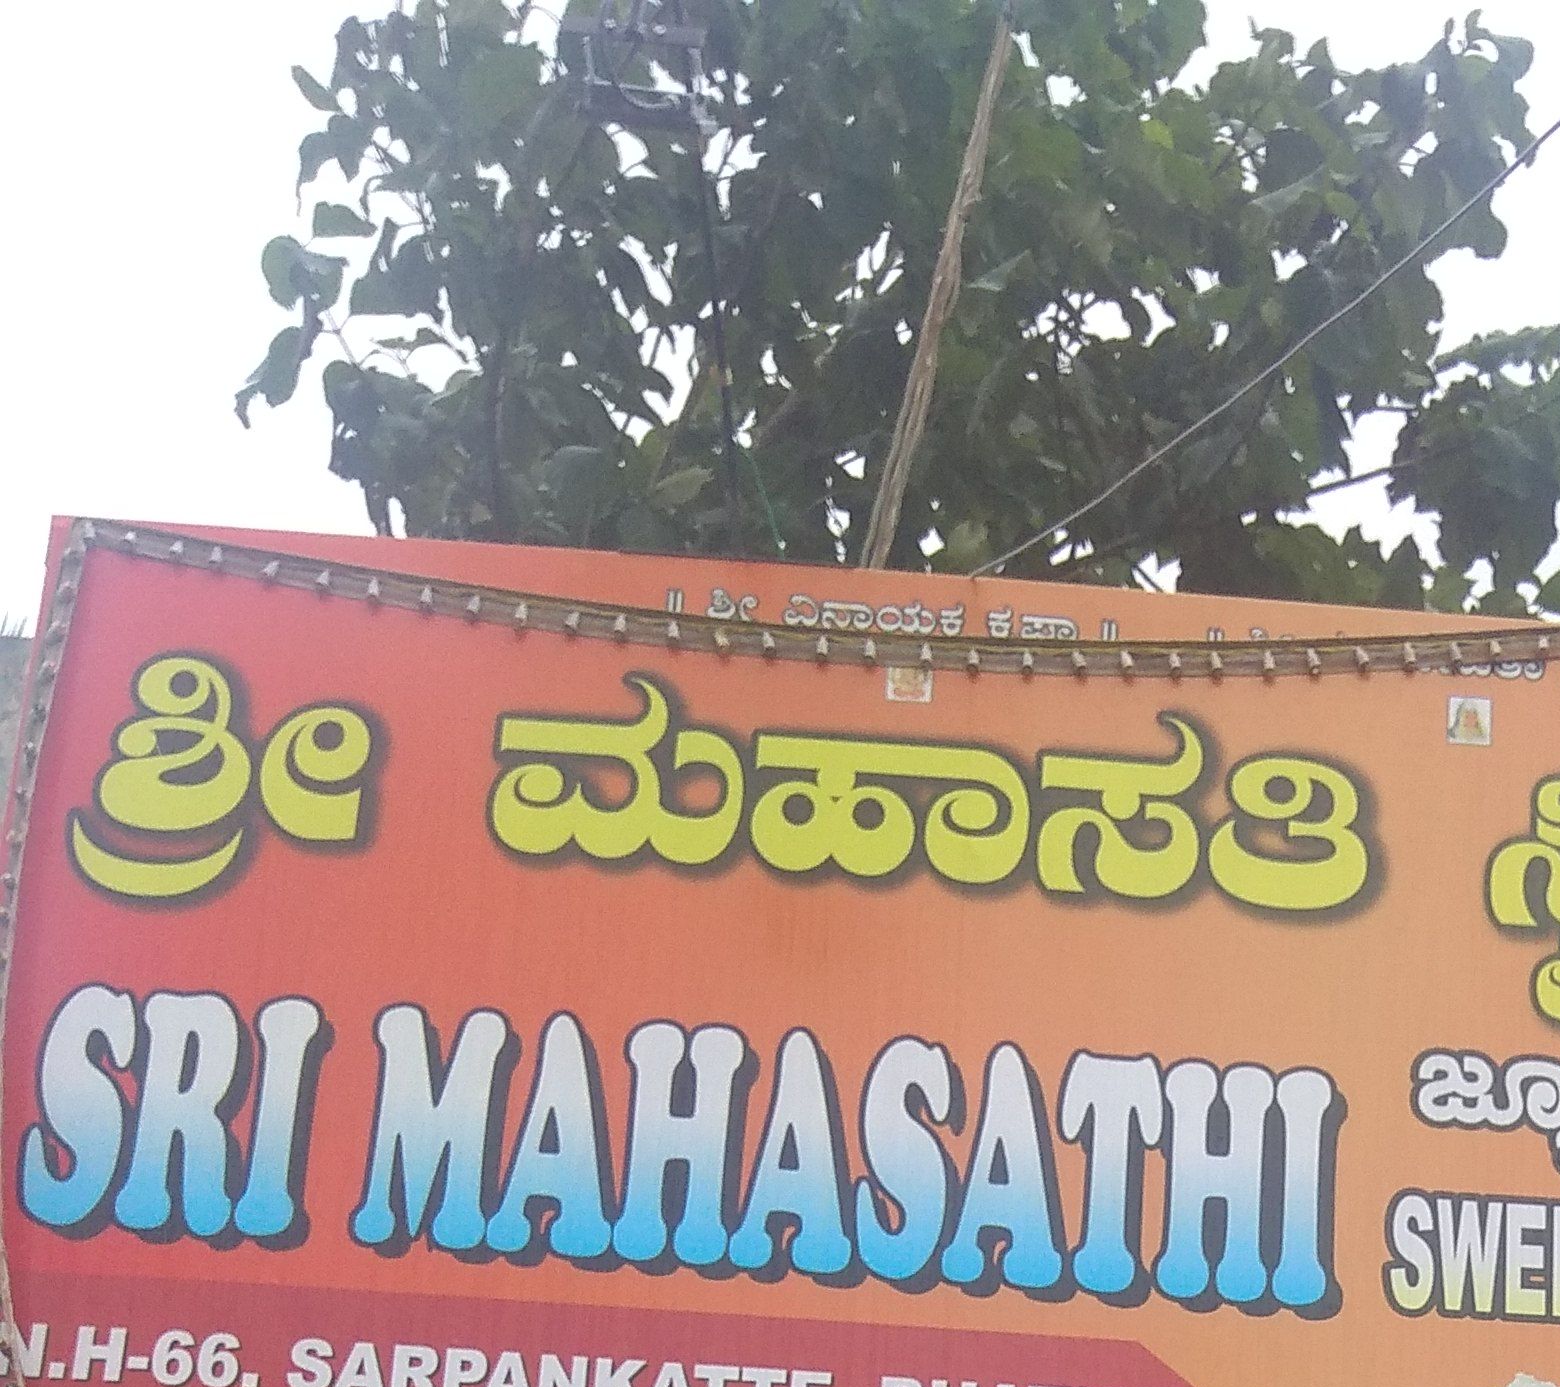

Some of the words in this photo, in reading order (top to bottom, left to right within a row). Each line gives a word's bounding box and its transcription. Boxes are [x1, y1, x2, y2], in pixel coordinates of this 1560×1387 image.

[70, 655, 373, 899] ಶ್ರೀ
[490, 674, 1370, 912] ಮಹಾಸತಿ
[22, 983, 325, 1243] SRI
[350, 1001, 1338, 1312] MAHASATHI
